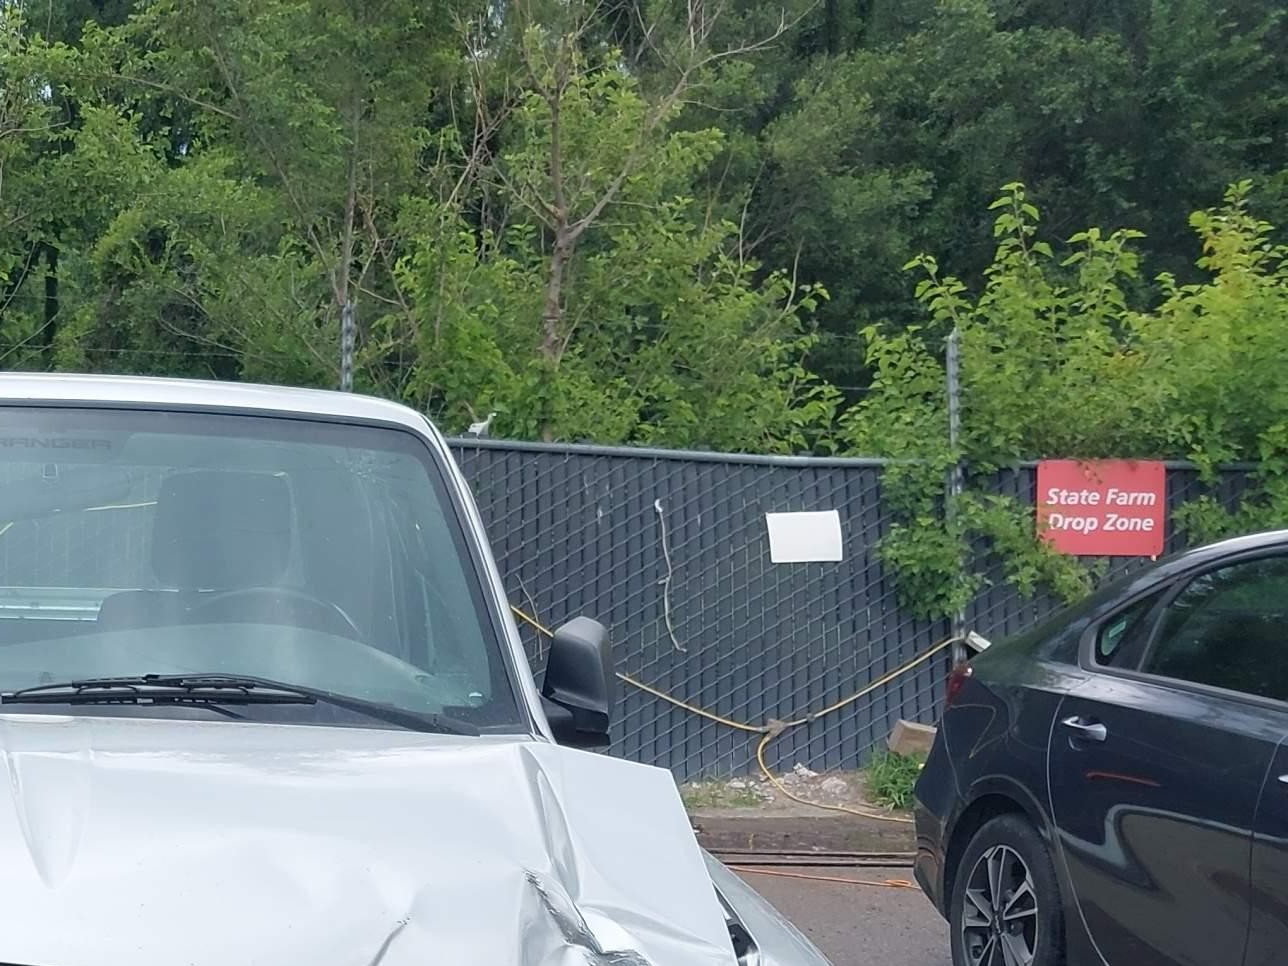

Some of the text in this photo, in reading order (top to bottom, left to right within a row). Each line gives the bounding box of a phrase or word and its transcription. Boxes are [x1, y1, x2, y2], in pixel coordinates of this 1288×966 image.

[1046, 487, 1157, 506] State Farm
[1048, 513, 1155, 535] Drop Zone
